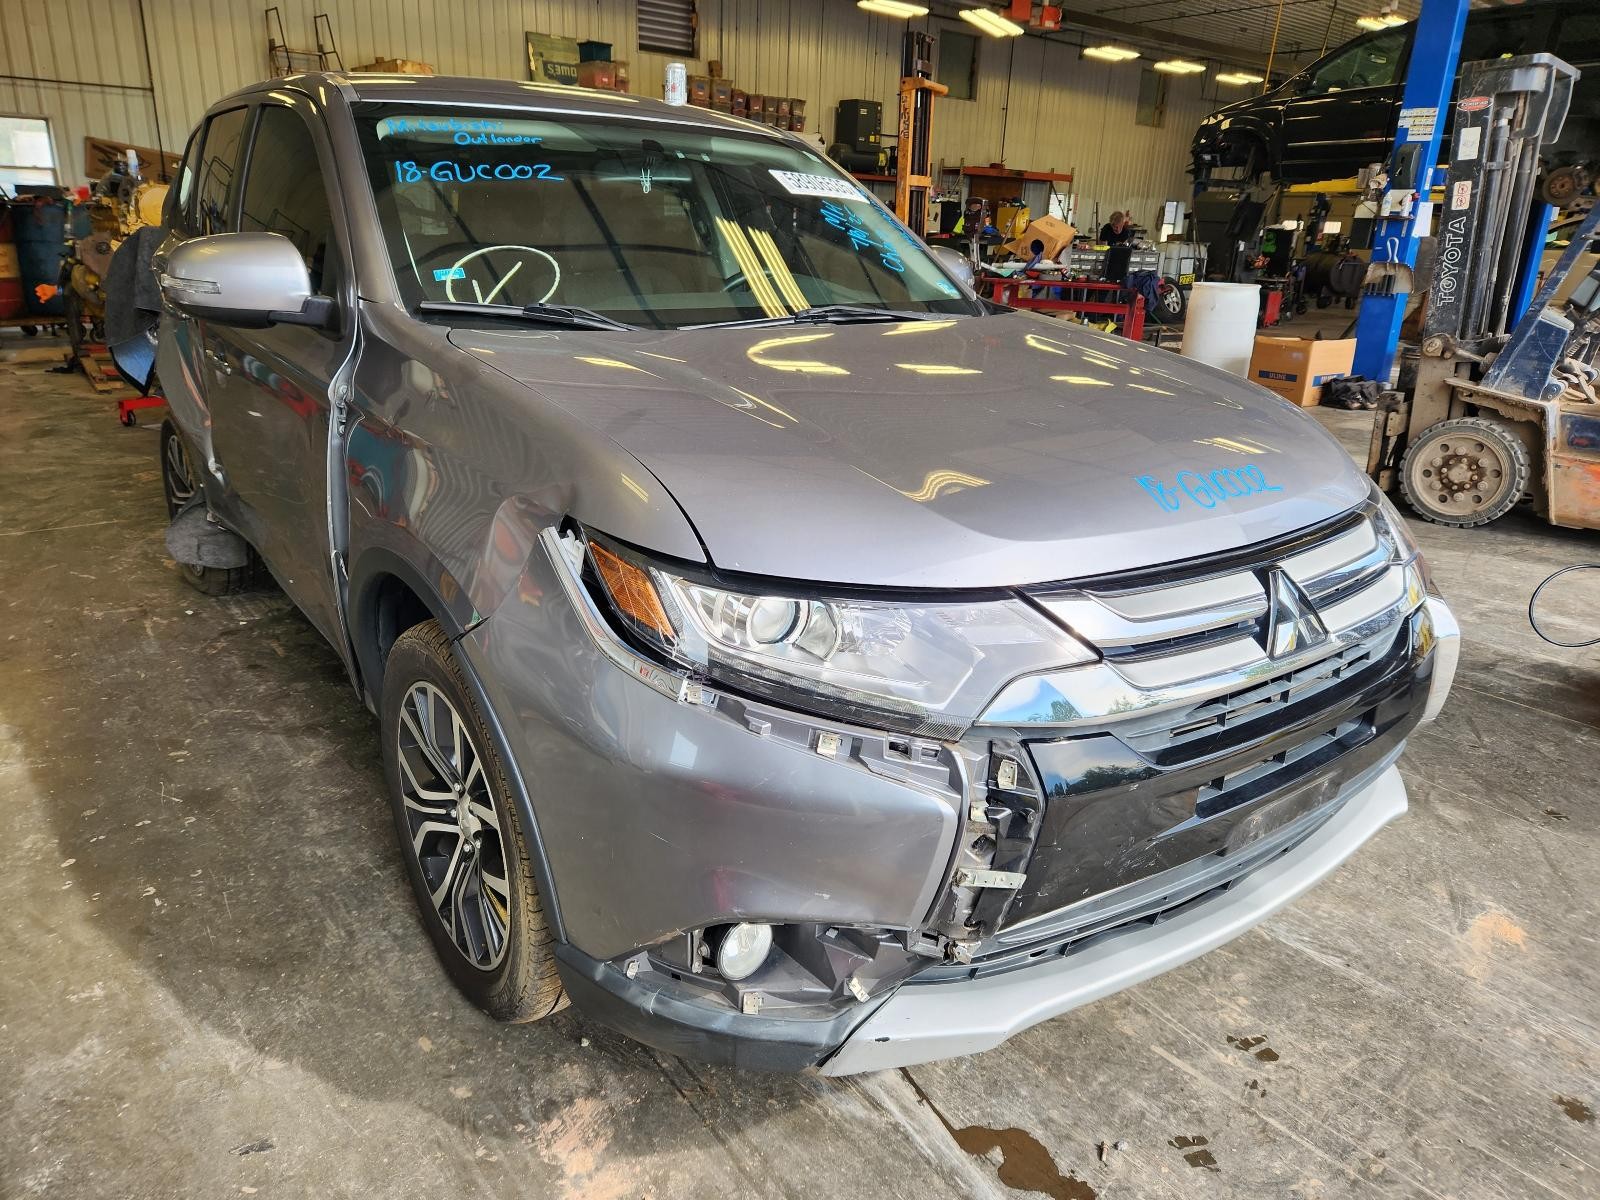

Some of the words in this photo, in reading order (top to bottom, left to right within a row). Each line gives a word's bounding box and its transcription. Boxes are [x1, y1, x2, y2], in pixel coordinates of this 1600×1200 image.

[547, 63, 577, 78] OWE'S
[395, 160, 564, 183] 18-GUC002
[1437, 216, 1467, 307] TOYOTA
